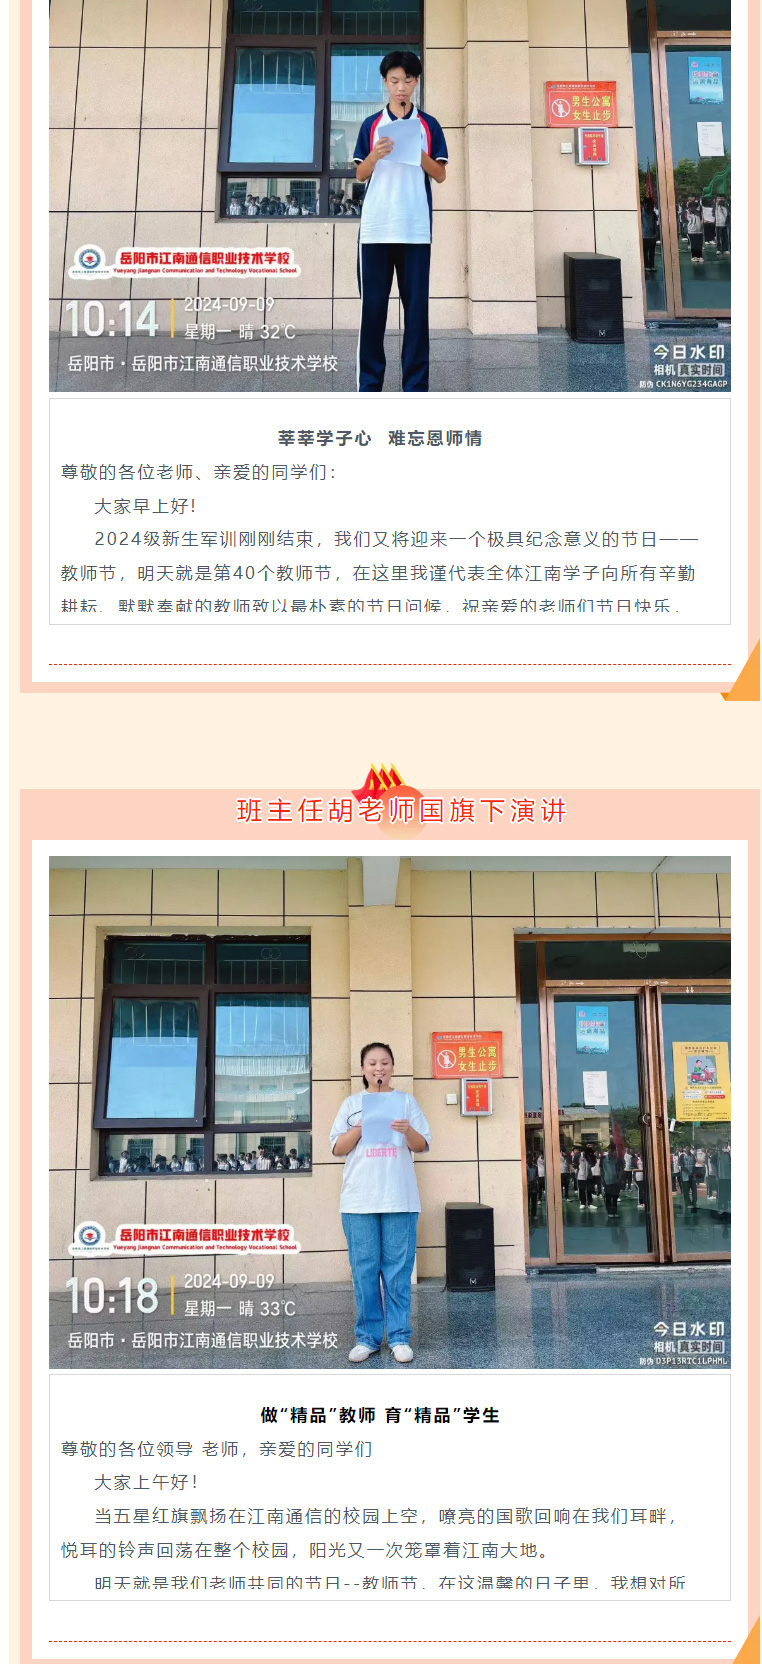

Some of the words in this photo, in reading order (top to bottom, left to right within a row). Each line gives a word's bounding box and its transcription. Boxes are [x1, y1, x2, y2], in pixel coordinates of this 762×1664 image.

[572, 96, 611, 108] 男生公寓
[572, 110, 611, 121] 女生止步
[278, 430, 371, 446] 莘莘学子心
[388, 430, 482, 446] 难忘恩师情
[236, 798, 567, 824] 班主任胡老师国旗下演讲
[458, 1046, 496, 1058] 男生公寓
[458, 1061, 497, 1072] 女生止步
[61, 1441, 193, 1457] 尊敬的各位领导
[202, 1441, 371, 1457] 老师，亲爱的同学们
